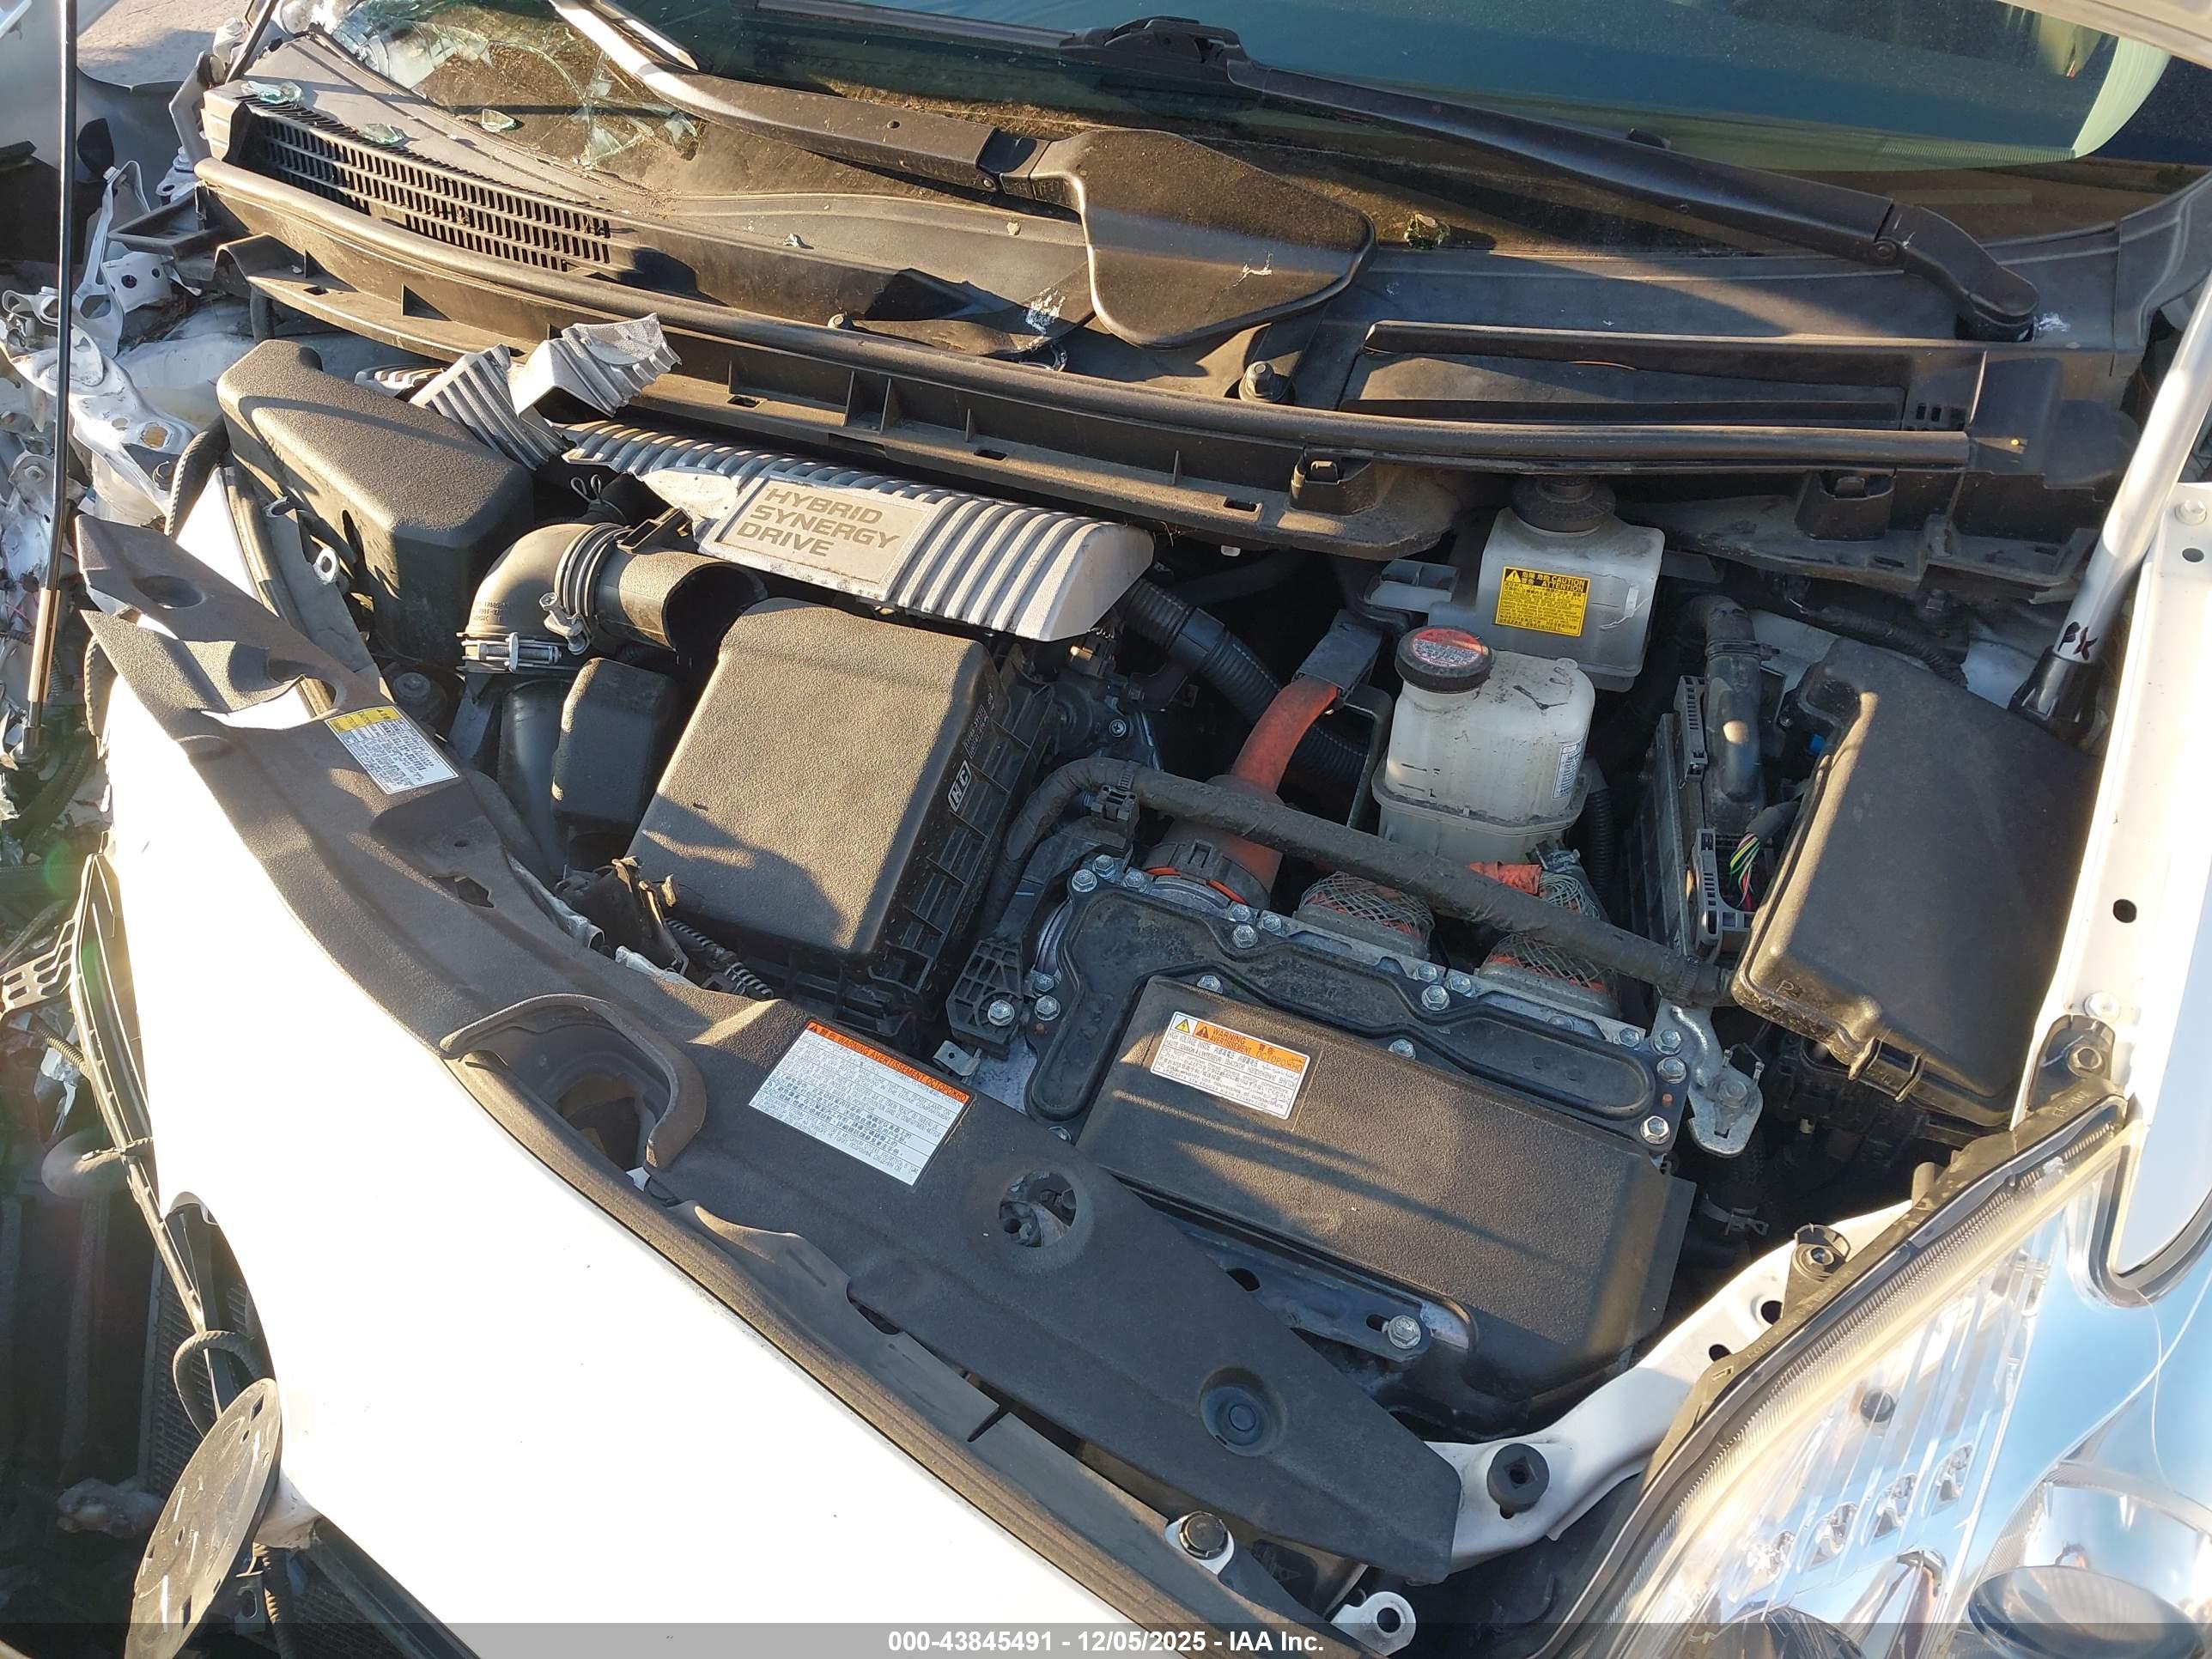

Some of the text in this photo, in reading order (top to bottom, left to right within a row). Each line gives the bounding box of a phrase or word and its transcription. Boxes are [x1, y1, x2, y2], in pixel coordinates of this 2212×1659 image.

[764, 489, 883, 525] HYBRID
[737, 521, 835, 557] DRIVE
[750, 504, 901, 550] SYNERGY
[1541, 580, 1583, 592] ATTENTION
[1551, 574, 1585, 586] CAUTION
[1208, 1034, 1252, 1054] AVERTISSEMENT
[1212, 1027, 1246, 1045] WARNING
[836, 1036, 871, 1055] WARNING
[867, 1051, 926, 1081] AVERTISSEMENT
